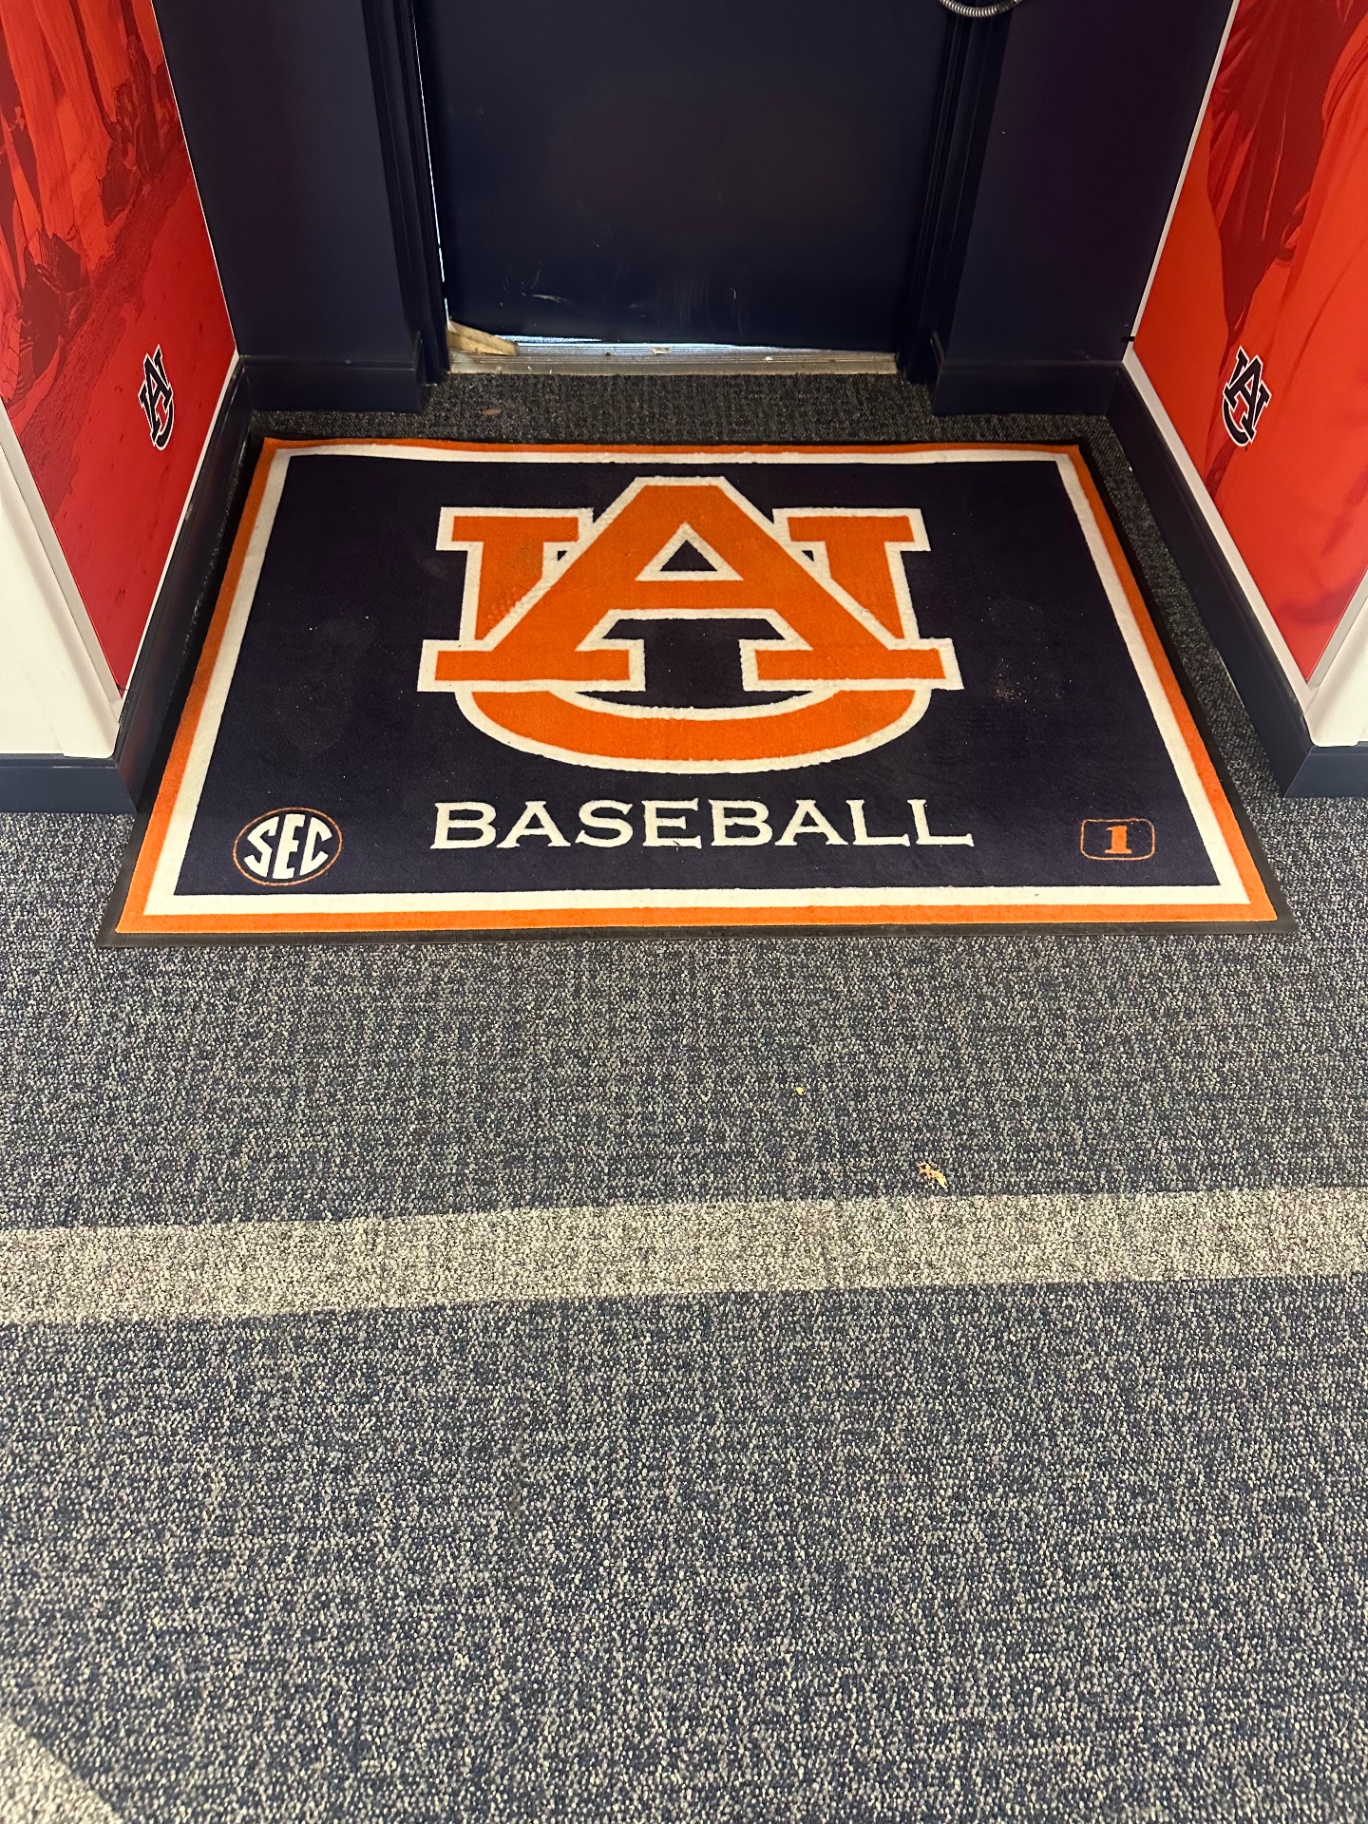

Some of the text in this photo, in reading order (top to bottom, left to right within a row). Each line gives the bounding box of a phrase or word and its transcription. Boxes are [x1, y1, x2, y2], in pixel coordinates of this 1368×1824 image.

[243, 812, 333, 880] SEC
[430, 798, 974, 850] BASEBALL
[1104, 824, 1133, 855] 1
